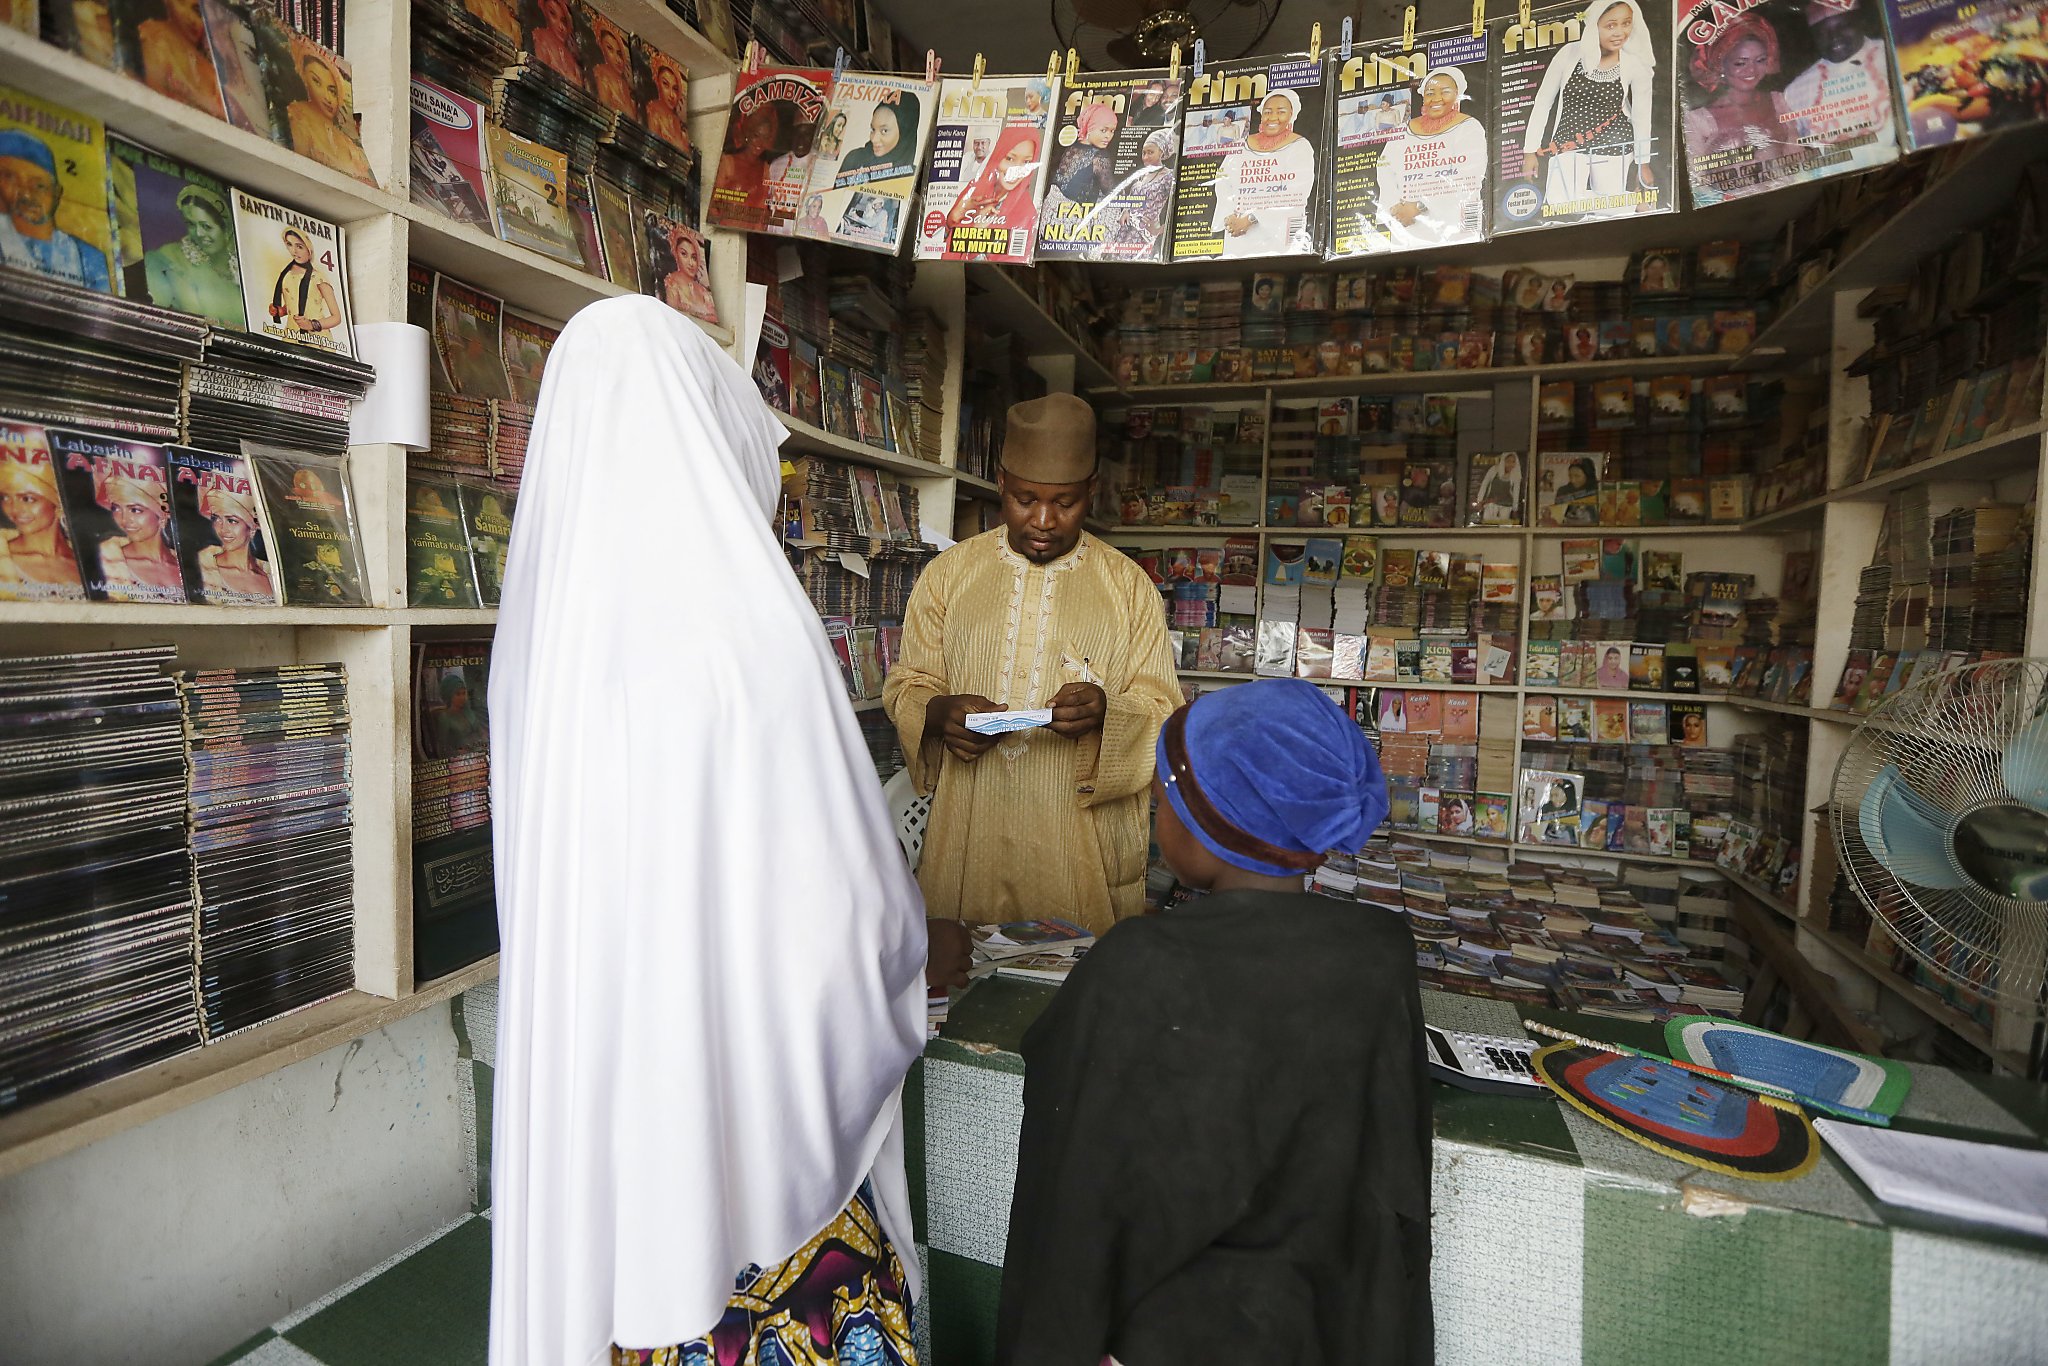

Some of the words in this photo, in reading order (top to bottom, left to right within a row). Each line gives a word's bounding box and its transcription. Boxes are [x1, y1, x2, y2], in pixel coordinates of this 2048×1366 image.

[1502, 19, 1580, 53] fim
[1339, 52, 1427, 92] fim
[837, 83, 902, 106] TASKIRA
[1189, 70, 1267, 105] fim
[429, 96, 459, 118] SANA'A
[739, 81, 822, 123] GAMBIZA
[942, 88, 1007, 118] fim
[1065, 89, 1126, 115] fim
[1404, 141, 1446, 154] A'ISHA
[1404, 151, 1438, 162] IDRIS
[65, 159, 77, 177] 2
[1240, 166, 1271, 176] IDRIS
[1241, 158, 1278, 168] A'ISHA
[1404, 155, 1467, 170] DANKANO
[1240, 172, 1296, 184] DANKANO
[1403, 173, 1423, 181] 1972
[544, 183, 559, 208] 2
[1239, 187, 1256, 195] 1972
[1581, 201, 1592, 211] DA
[1608, 195, 1626, 208] ZAN
[239, 194, 284, 224] SANYIN
[285, 211, 332, 241] LA'ASAR
[953, 227, 992, 240] AUREN
[993, 228, 1008, 240] TA
[1044, 223, 1105, 241] NIJAR
[952, 240, 966, 253] YA
[967, 241, 1006, 254] MUTU!
[320, 250, 335, 272] 4
[446, 296, 495, 324] ZUMUNCI!
[262, 321, 286, 338] Amina
[286, 328, 322, 346] Abdullahi
[507, 326, 553, 349] ZUMUNC
[55, 435, 133, 460] Labarin
[166, 450, 234, 474] Labarin
[177, 466, 253, 497] AFNA
